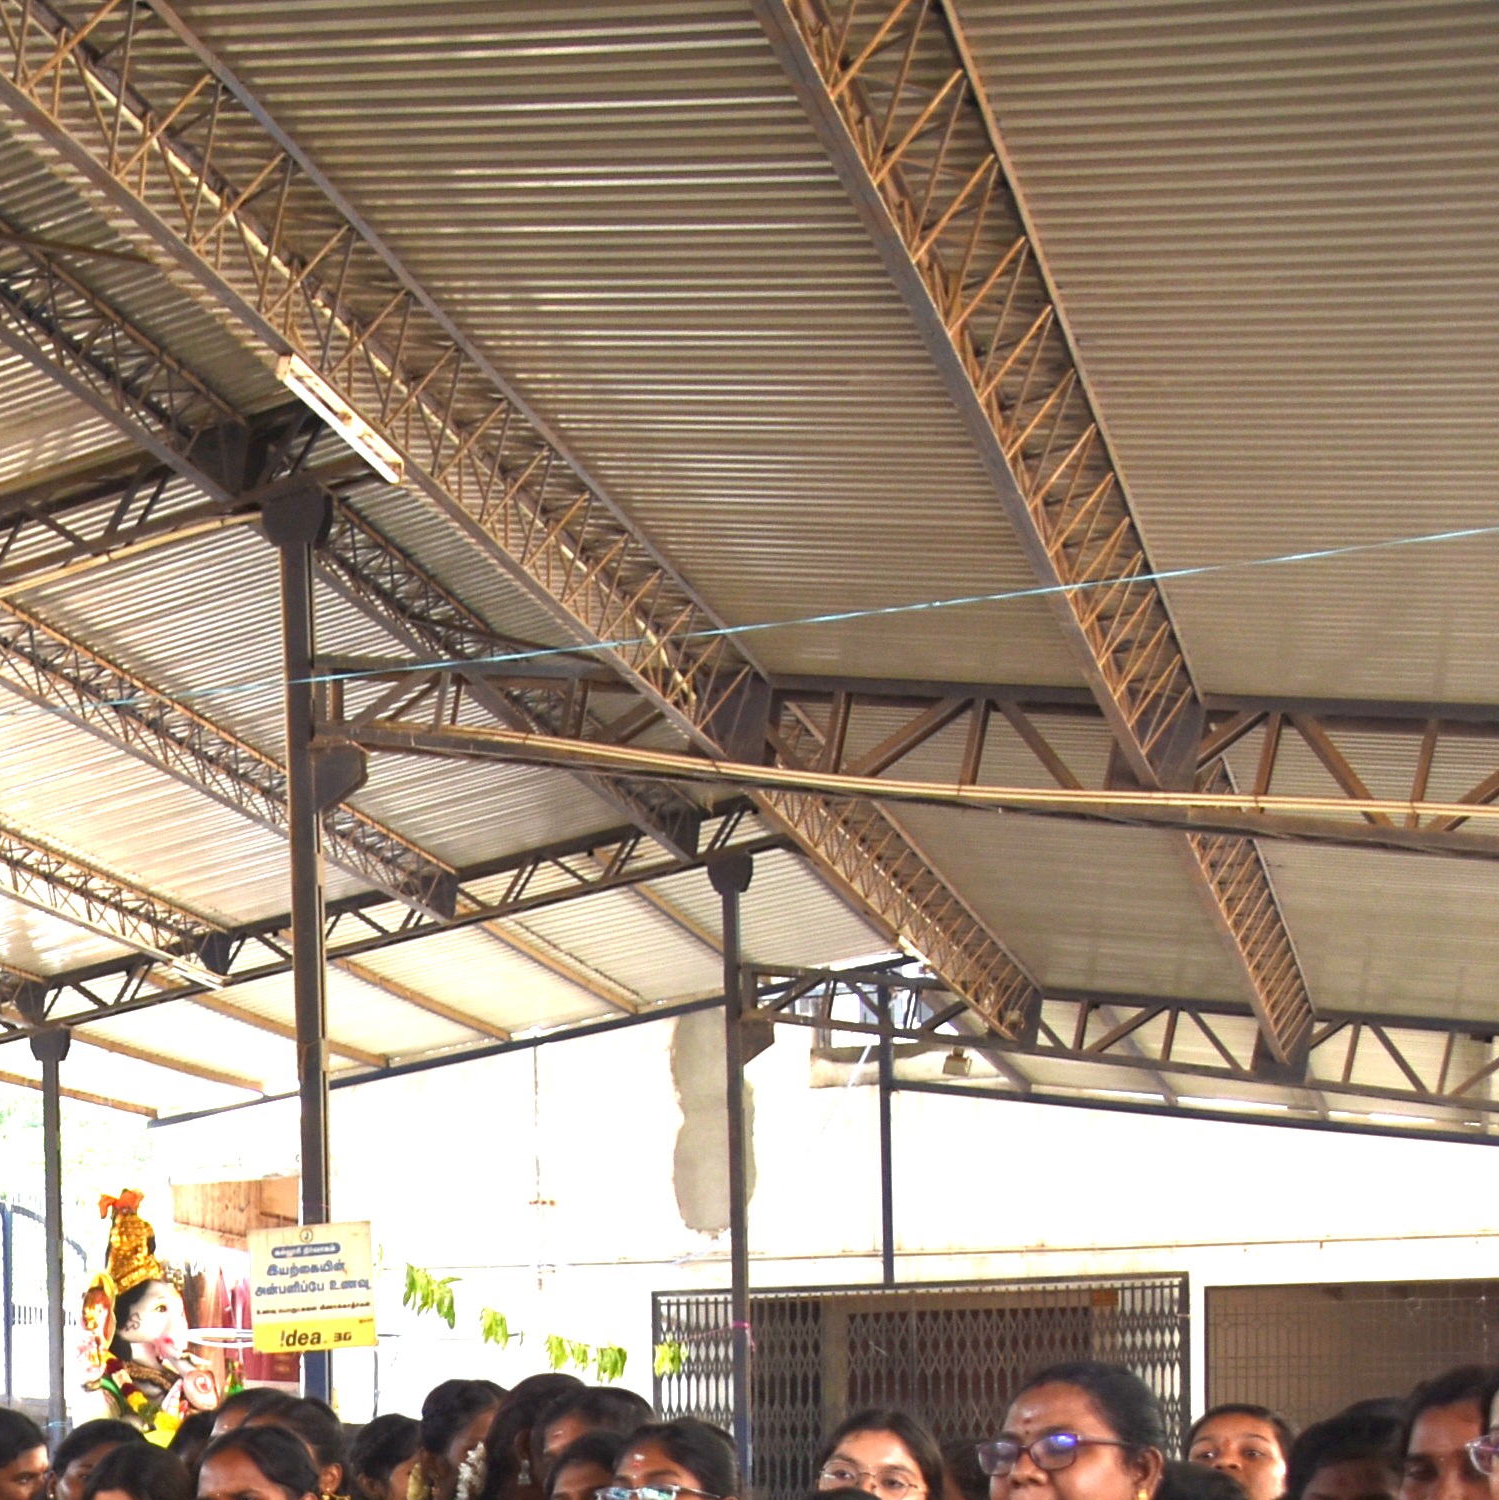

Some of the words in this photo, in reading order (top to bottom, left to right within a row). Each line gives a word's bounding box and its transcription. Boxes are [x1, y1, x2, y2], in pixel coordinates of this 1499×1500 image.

[267, 1259, 345, 1278] இயற்கையின்
[255, 1280, 324, 1296] அன்பளிப்பே
[330, 1279, 372, 1290] உணவு
